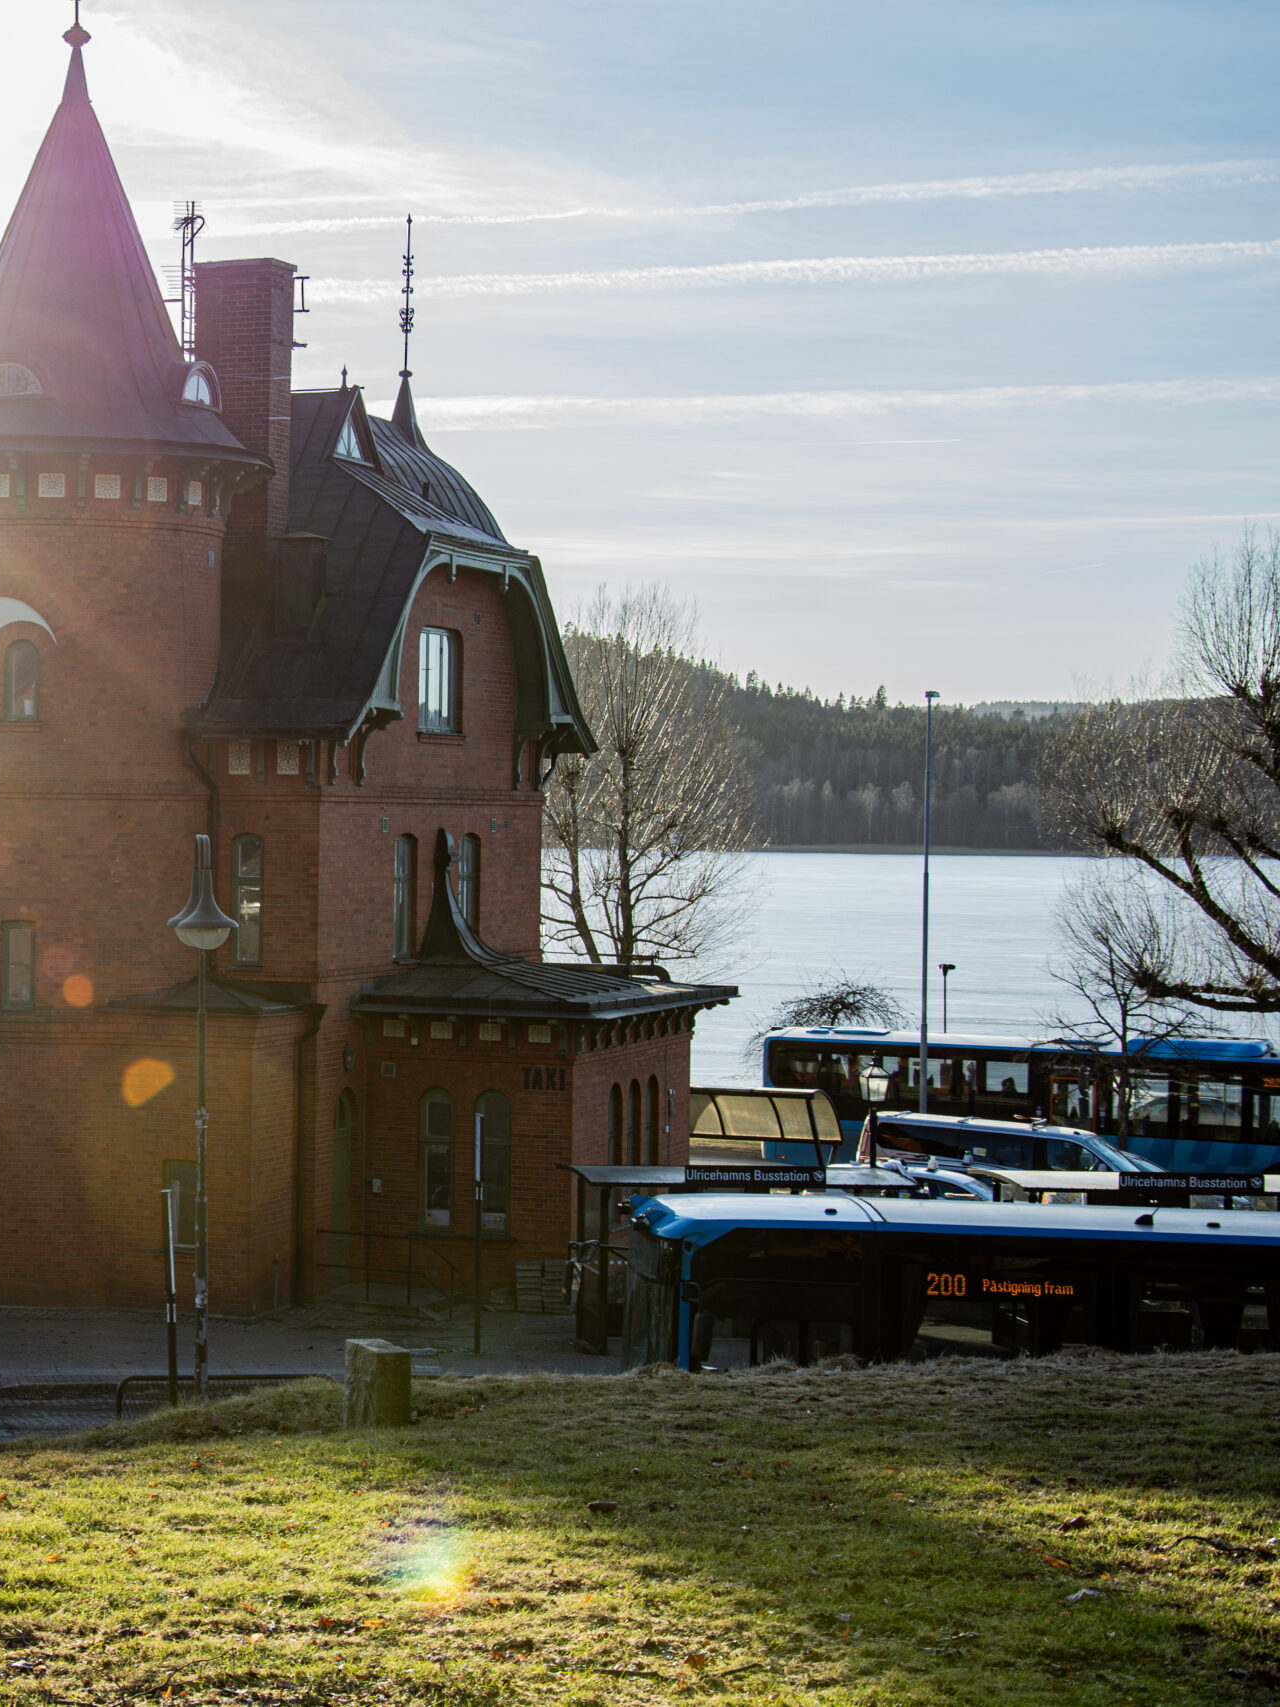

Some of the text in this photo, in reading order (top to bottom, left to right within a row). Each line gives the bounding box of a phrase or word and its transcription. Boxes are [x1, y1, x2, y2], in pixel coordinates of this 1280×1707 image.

[522, 1067, 565, 1090] TAXI
[686, 1169, 810, 1182] Ulricehamns Busstation
[1120, 1175, 1248, 1189] Ulricehamns Busstation
[927, 1273, 1074, 1297] 200 Påstigning fram
